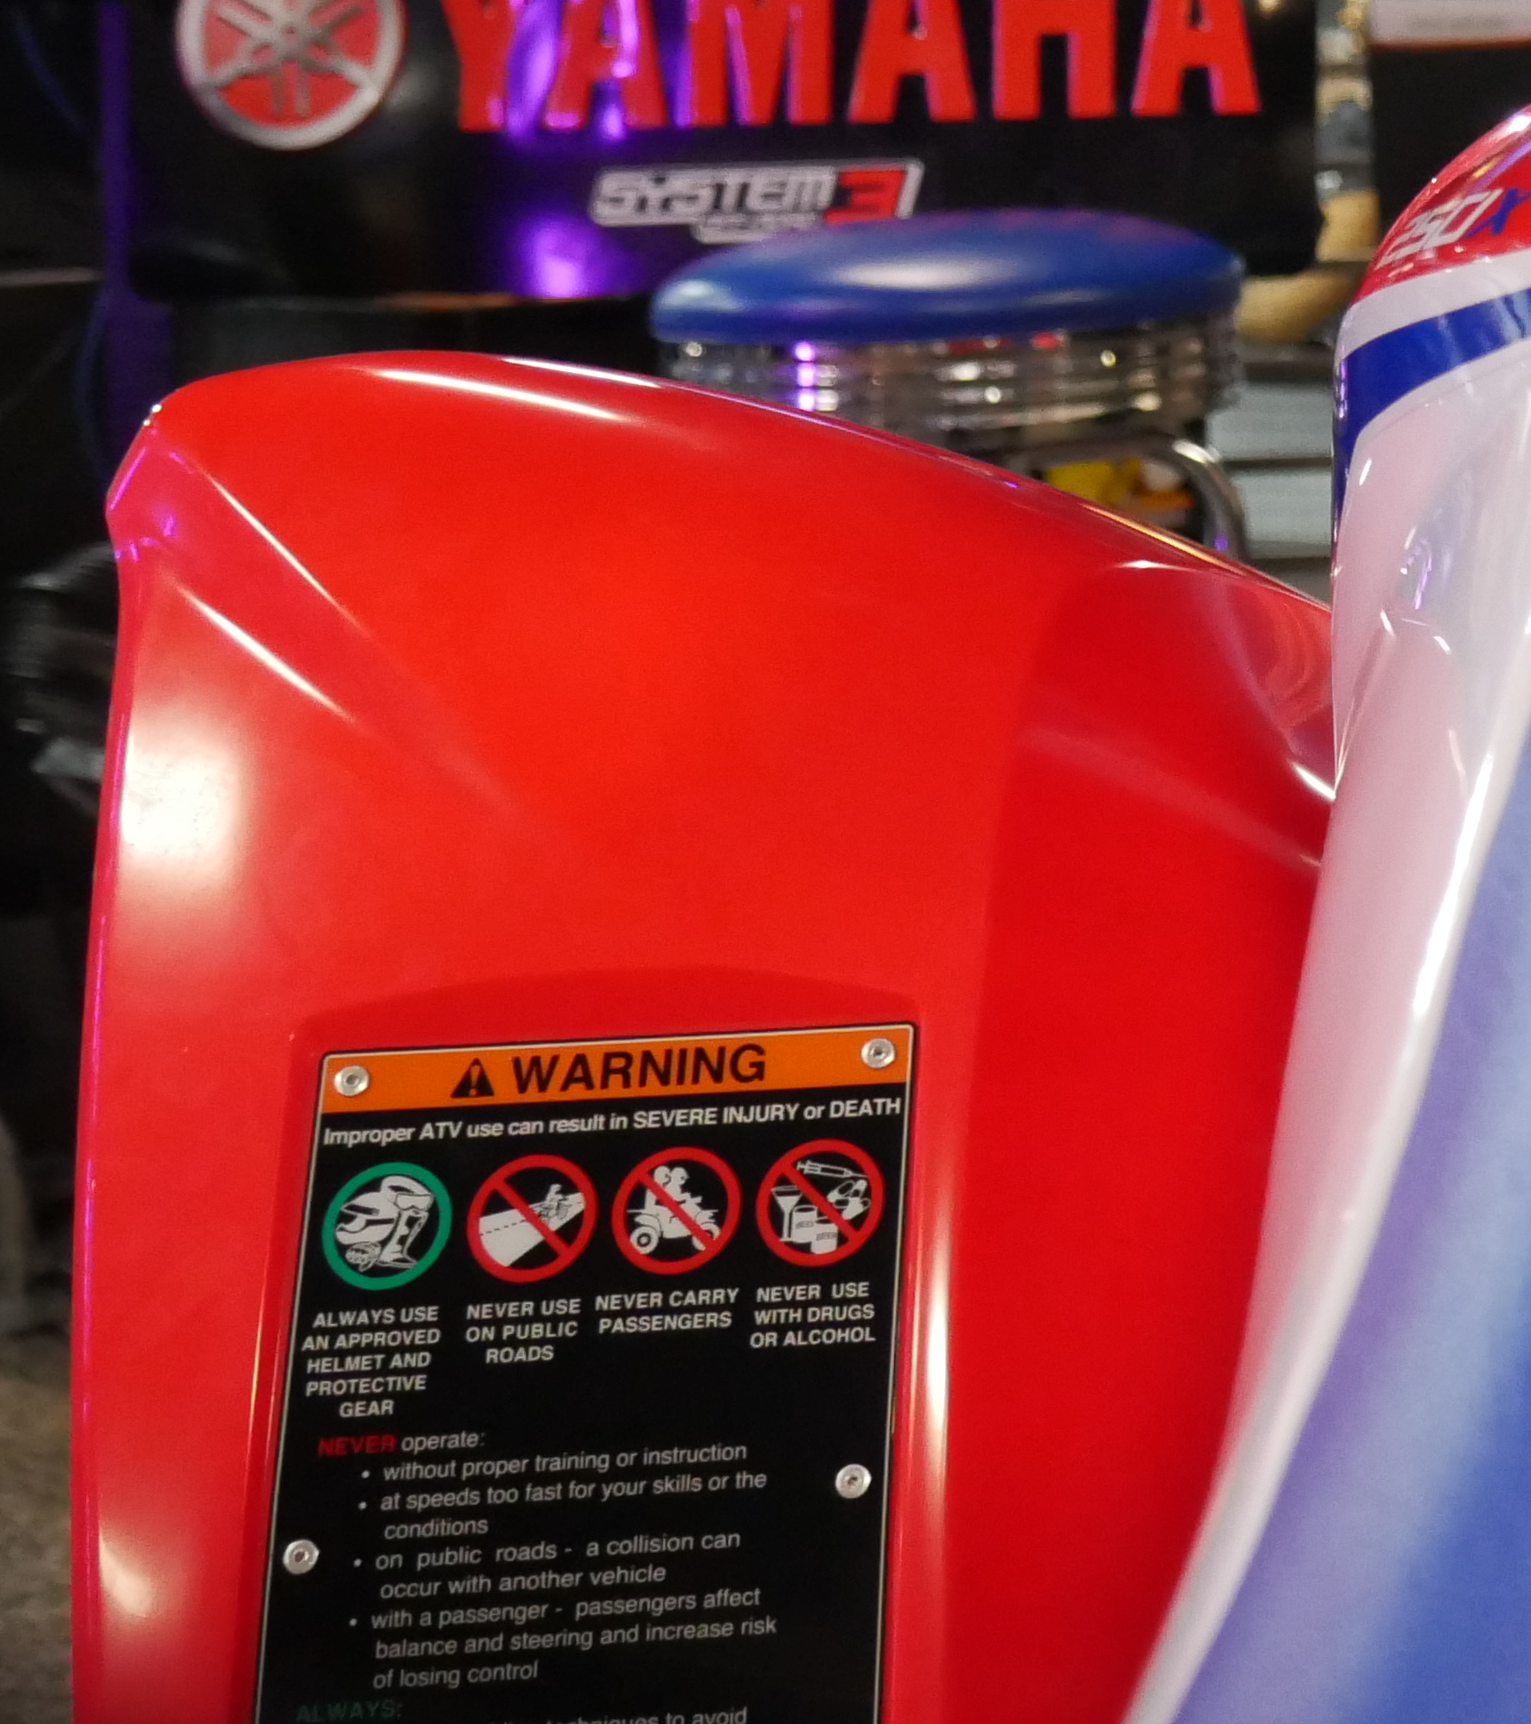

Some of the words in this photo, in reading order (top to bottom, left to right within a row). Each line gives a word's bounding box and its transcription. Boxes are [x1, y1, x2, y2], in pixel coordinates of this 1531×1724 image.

[512, 1043, 766, 1095] WARNING
[323, 1127, 416, 1148] Improper
[419, 1121, 463, 1140] ATV
[466, 1122, 504, 1138] use
[507, 1120, 544, 1136] can
[548, 1114, 606, 1133] result
[609, 1112, 628, 1130] in
[633, 1107, 718, 1129] SEVERE
[722, 1102, 800, 1124] INJURY
[803, 1105, 826, 1120] or
[829, 1097, 901, 1119] DEATH
[595, 1292, 663, 1311] NEVER
[669, 1287, 739, 1307] CARRY
[756, 1284, 821, 1302] NEVER
[832, 1281, 869, 1299] USE
[313, 1308, 395, 1328] ALWAYS
[400, 1305, 439, 1323] USE
[466, 1301, 534, 1320] NEVER
[541, 1298, 581, 1316] USE
[754, 1308, 802, 1325] WITH
[807, 1303, 875, 1323] DRUGS
[465, 1326, 495, 1343] ON
[502, 1320, 578, 1340] PUBLIC
[599, 1311, 732, 1334] PASSENGERS
[301, 1335, 329, 1351] AN
[334, 1328, 441, 1349] APPROVED
[750, 1331, 778, 1349] OR
[783, 1326, 876, 1346] ALCOHOL
[307, 1354, 385, 1374] HELMET
[389, 1351, 431, 1369] AND
[486, 1344, 554, 1364] ROADS
[306, 1374, 427, 1397] PROTECTIVE
[339, 1399, 394, 1418] GEAR
[319, 1434, 397, 1456] NEVER
[383, 1459, 457, 1481] without
[461, 1458, 530, 1481] proper
[535, 1451, 610, 1474] training
[616, 1452, 638, 1468] or
[643, 1443, 747, 1466] instruction
[380, 1492, 401, 1511] at
[405, 1487, 481, 1513] speeds
[487, 1486, 519, 1504] too
[525, 1482, 563, 1502] fast
[568, 1480, 596, 1500] for
[601, 1480, 647, 1502] your
[652, 1473, 703, 1495] skills
[708, 1475, 730, 1491] or
[735, 1470, 767, 1489] the
[384, 1518, 489, 1540] conditions
